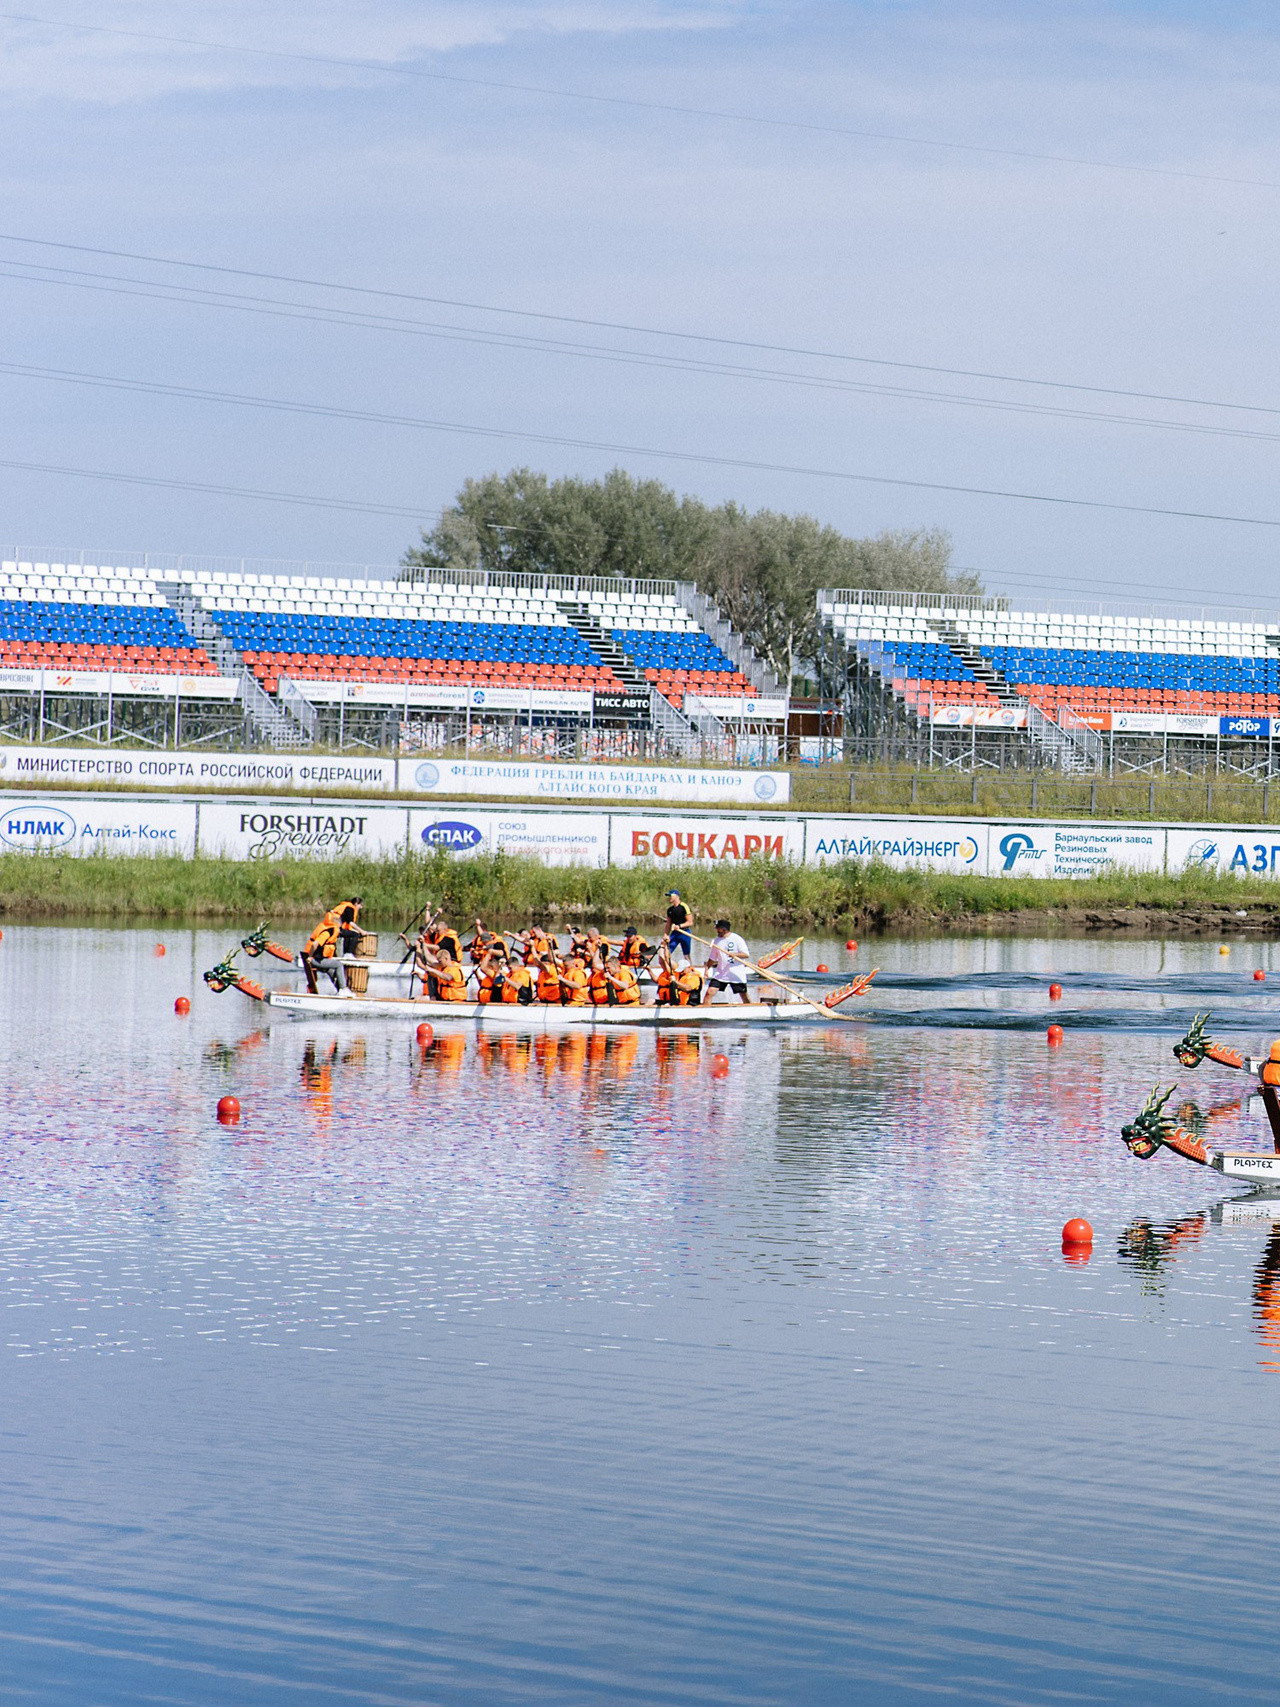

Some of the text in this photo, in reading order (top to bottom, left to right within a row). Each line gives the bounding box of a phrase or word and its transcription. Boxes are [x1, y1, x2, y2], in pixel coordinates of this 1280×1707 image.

[595, 698, 650, 709] ТИСС АВТО
[1229, 720, 1261, 733] РОТОР
[17, 758, 382, 783] МИНИСТЕРСТВО СПОРТА РОССИЙСКОЙ ФЕДЕРАЦИИ
[450, 766, 742, 786] ФЕДЕРАЦИЯ ГРЕБЛИ НА БАЙДАРКАХ И КАНОЭ
[537, 781, 658, 795] АЛТАЙСКОГО КРАЯ
[7, 820, 66, 836] НЛМК
[240, 813, 368, 835] FORSHTADT
[498, 822, 527, 831] СОЮЗ
[81, 823, 177, 840] Алтай-Кокс
[427, 829, 475, 844] СПАК
[1055, 832, 1153, 845] Барнаульский завод
[249, 829, 351, 859] Brewery
[498, 834, 598, 844] ПРОМЫШЛЕННИКОВ
[631, 831, 784, 860] БОЧКАРИ
[564, 847, 589, 855] КРАЯ
[1054, 844, 1108, 853] Резиновых
[1054, 854, 1113, 864] Технических
